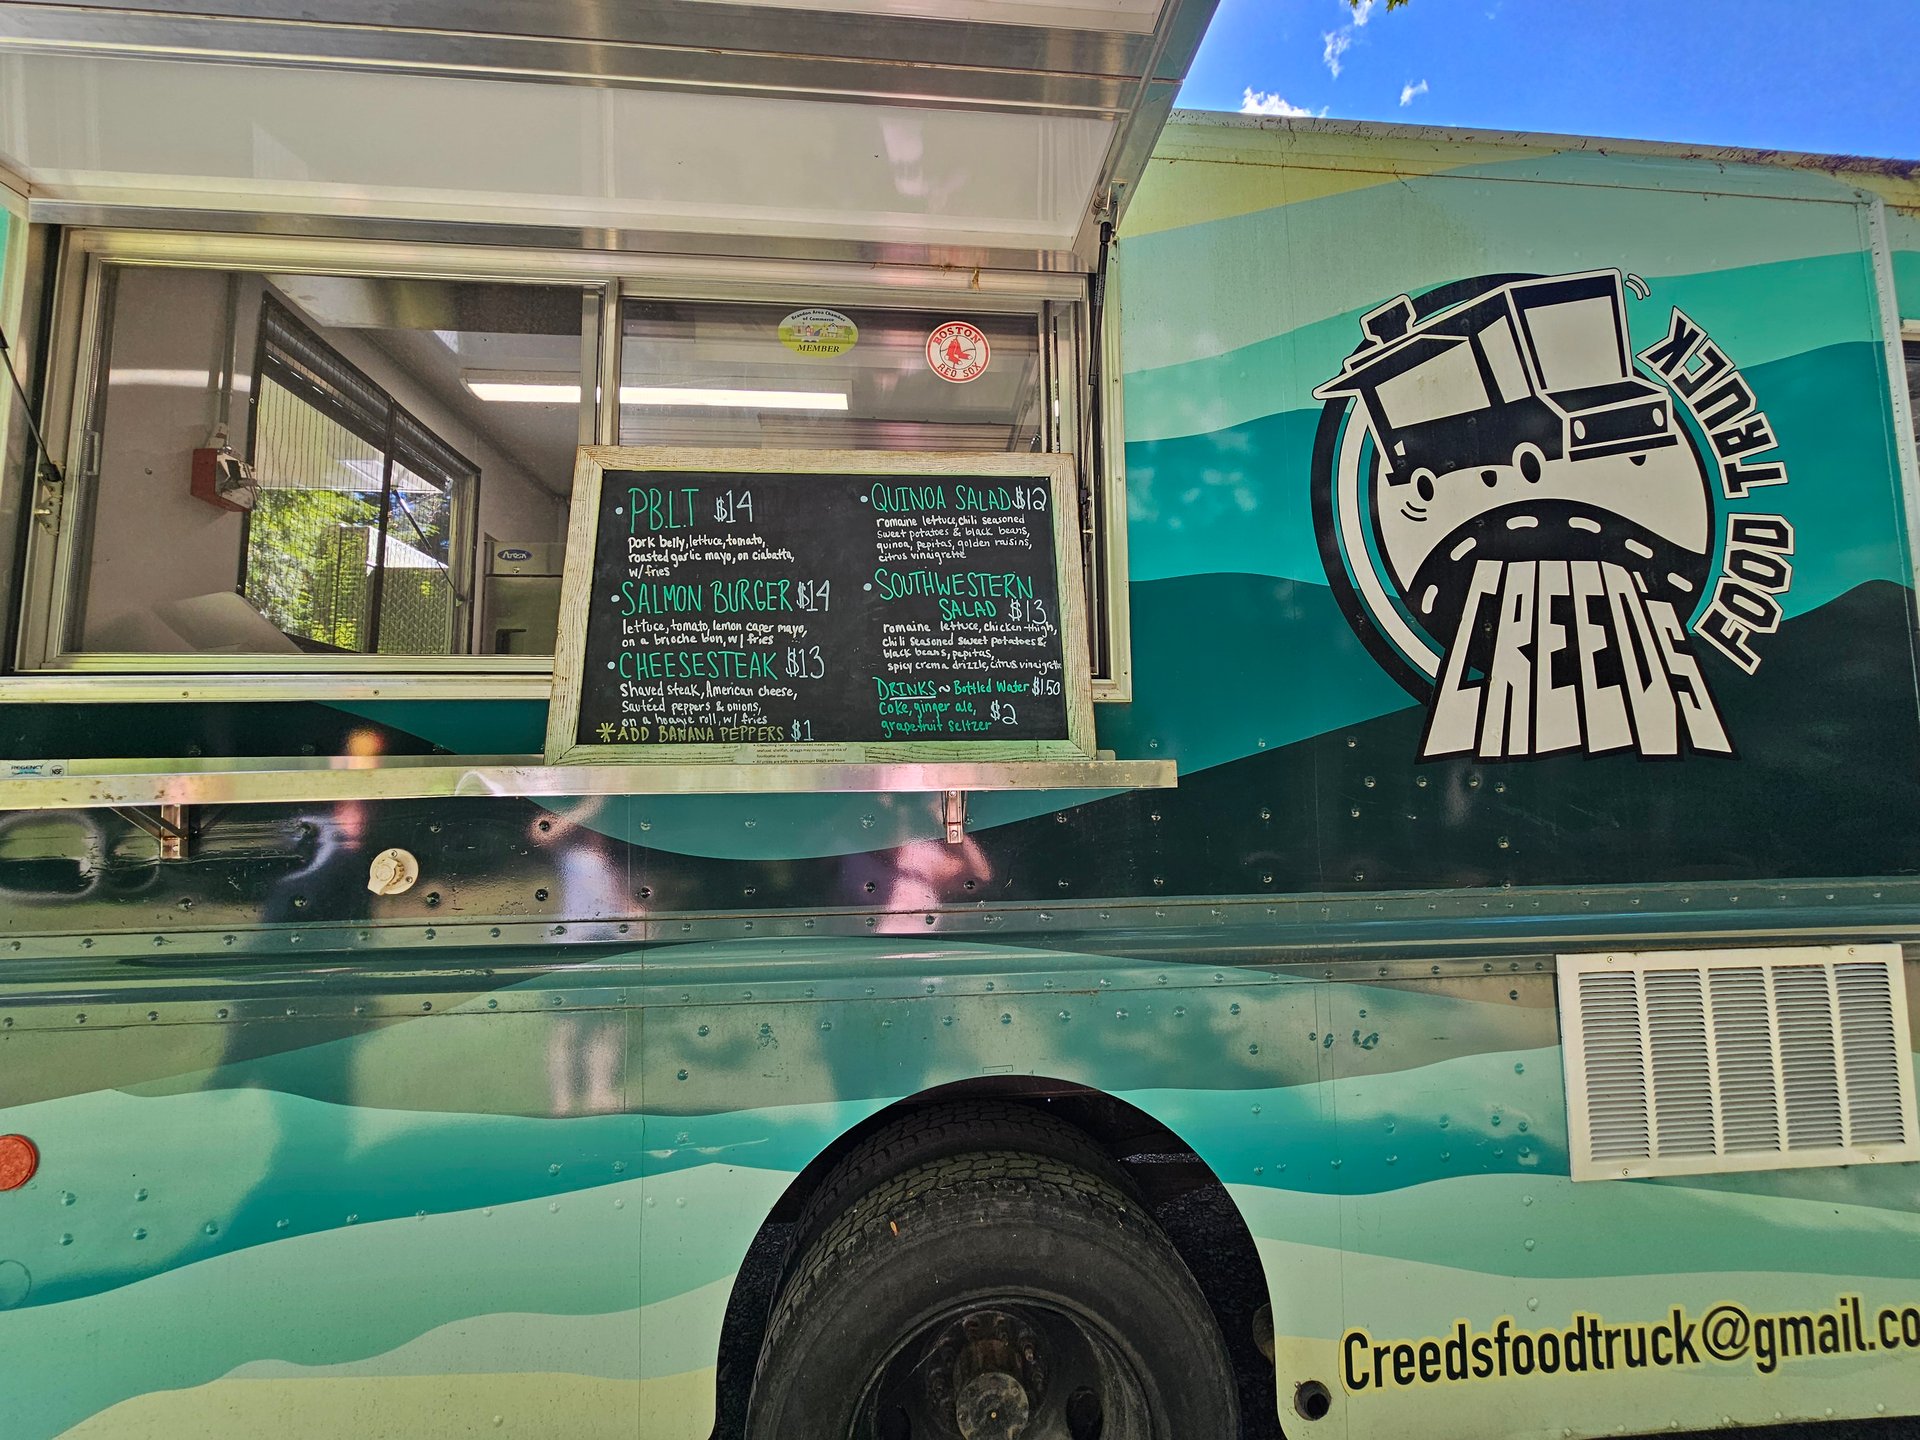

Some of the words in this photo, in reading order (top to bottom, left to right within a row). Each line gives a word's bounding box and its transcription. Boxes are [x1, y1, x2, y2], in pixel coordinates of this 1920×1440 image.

[933, 326, 981, 345] BOSTON
[797, 344, 840, 353] MEMBER
[937, 363, 957, 378] RED
[963, 361, 981, 378] SOX
[1636, 305, 1789, 499] TRUCK
[713, 489, 753, 523] $14
[871, 482, 947, 513] QUINOA
[955, 484, 1011, 512] SALAD
[1011, 485, 1047, 512] $12
[876, 515, 918, 528] romaine
[922, 515, 958, 527] lettuce,
[982, 514, 1026, 525] seasoned
[659, 534, 689, 552] belly,
[689, 534, 726, 549] lettuce,
[726, 533, 766, 548] tomato,
[877, 528, 907, 539] sweet
[909, 527, 950, 541] potatoes
[952, 527, 962, 537] &
[965, 527, 993, 537] black
[998, 526, 1030, 538] beans,
[876, 542, 913, 553] quinoa,
[916, 539, 955, 551] pepitas,
[957, 538, 991, 552] golden
[994, 537, 1033, 550] raisins,
[628, 549, 669, 563] roasted
[670, 549, 702, 568] garlic
[705, 551, 736, 566] mayo,
[737, 552, 749, 561] on
[752, 548, 795, 563] ciabatta,
[878, 551, 908, 562] citrus
[911, 549, 967, 565] vinaigrette
[644, 564, 671, 577] fries
[874, 568, 1034, 601] SOUTHWESTERN
[1693, 512, 1795, 676] FOOD
[621, 581, 702, 616] SALMON
[709, 579, 793, 614] BURGER
[796, 579, 831, 612] $14
[939, 598, 997, 621] SALAD
[1008, 598, 1047, 625] $13
[622, 618, 669, 635] lettuce,
[670, 619, 710, 637] tomato,
[712, 619, 742, 631] lemon
[746, 619, 775, 634] caper
[777, 622, 808, 638] mayo,
[883, 621, 931, 633] romaine
[940, 621, 982, 634] lettuce,
[983, 621, 1022, 632] chicken
[1023, 622, 1058, 638] thigh,
[622, 637, 636, 648] on
[640, 636, 650, 646] a
[654, 633, 698, 645] brioche
[701, 632, 726, 647] bun,
[746, 633, 774, 646] fries
[957, 636, 989, 646] sweet
[991, 636, 1036, 647] potatoes
[1037, 637, 1047, 648] &
[619, 650, 778, 680] CHEESESTEAK
[785, 645, 825, 679] $13
[883, 648, 912, 659] black
[914, 647, 951, 660] beans,
[952, 649, 995, 661] pepitas,
[887, 661, 913, 674] spicy
[915, 661, 950, 670] crema
[952, 659, 989, 672] drizzle,
[990, 659, 1018, 669] citrus
[619, 681, 664, 697] Shaved
[667, 682, 705, 700] steak,
[706, 681, 754, 697] American
[758, 685, 798, 700] cheese,
[872, 676, 937, 700] DRINKS
[953, 678, 992, 695] Bottled
[996, 679, 1030, 693] Water
[671, 700, 711, 717] peppers
[715, 700, 725, 712] &
[727, 700, 762, 715] onions,
[913, 702, 951, 720] ginger
[955, 701, 977, 716] ale,
[990, 700, 1018, 725] $2
[617, 726, 650, 742] ADD
[658, 726, 715, 742] BANANA
[719, 725, 785, 742] PEPPERS
[790, 718, 815, 742] $1
[622, 717, 637, 728] on
[642, 716, 651, 725] a
[655, 714, 695, 732] hoagie
[699, 713, 721, 726] roll,
[741, 713, 768, 725] fries
[881, 717, 943, 739] grapefruit
